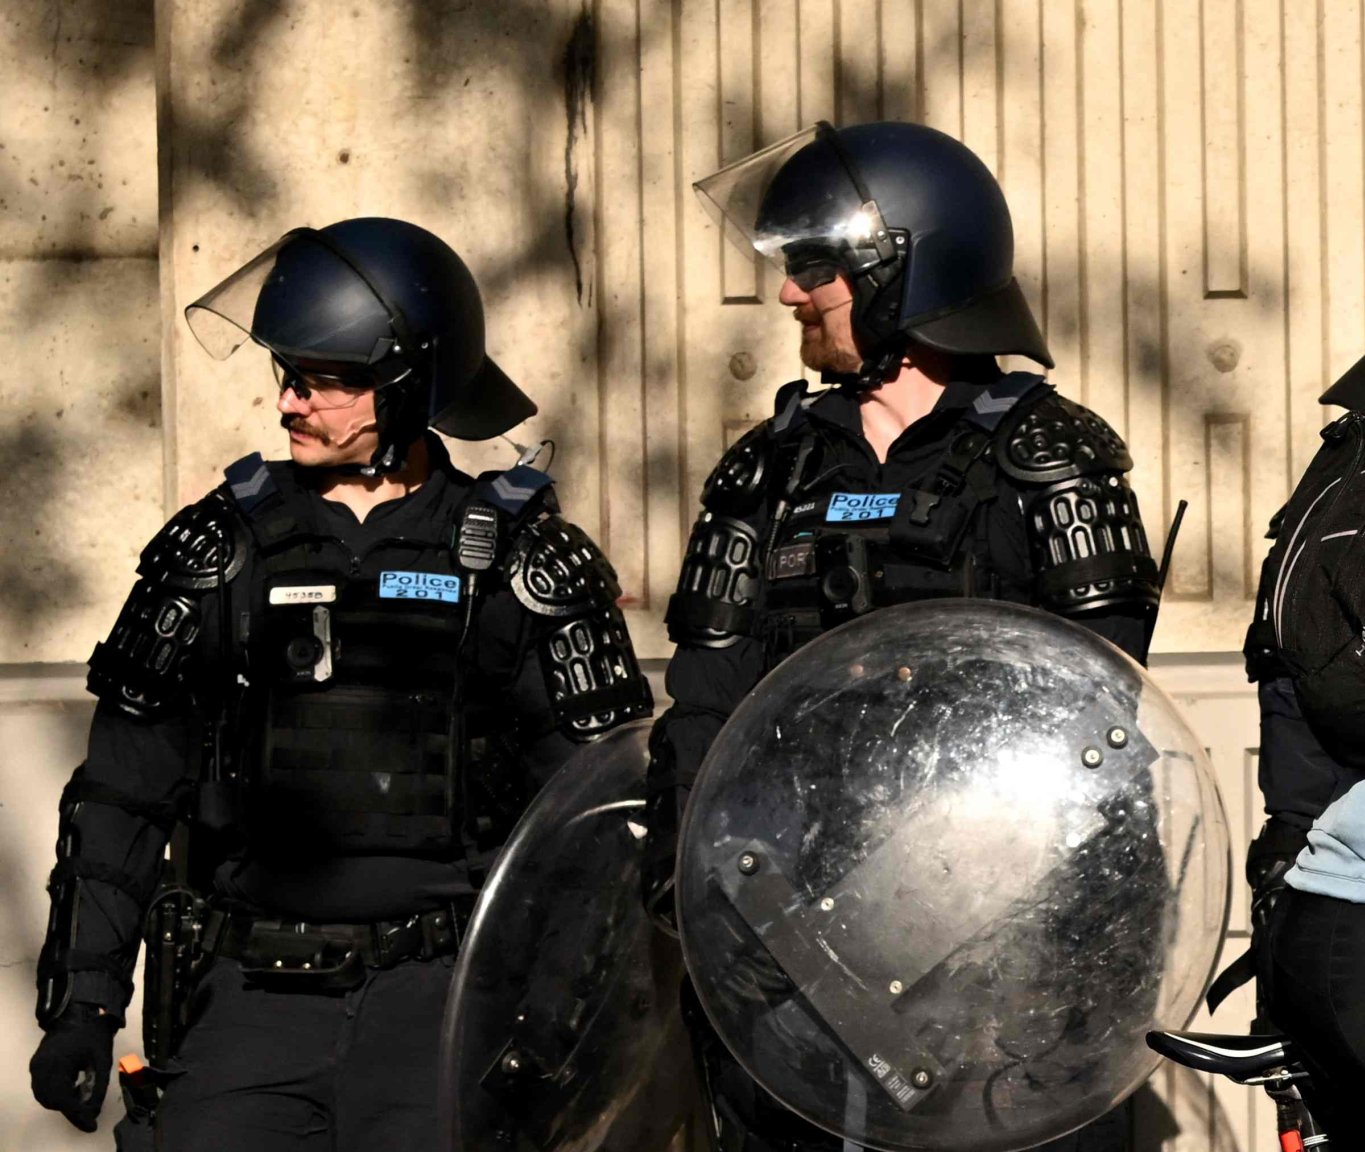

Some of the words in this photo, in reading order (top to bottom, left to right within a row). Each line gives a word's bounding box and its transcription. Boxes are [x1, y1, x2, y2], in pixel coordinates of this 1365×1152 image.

[841, 509, 884, 521] 201
[382, 573, 457, 589] Police
[396, 589, 444, 600] 201
